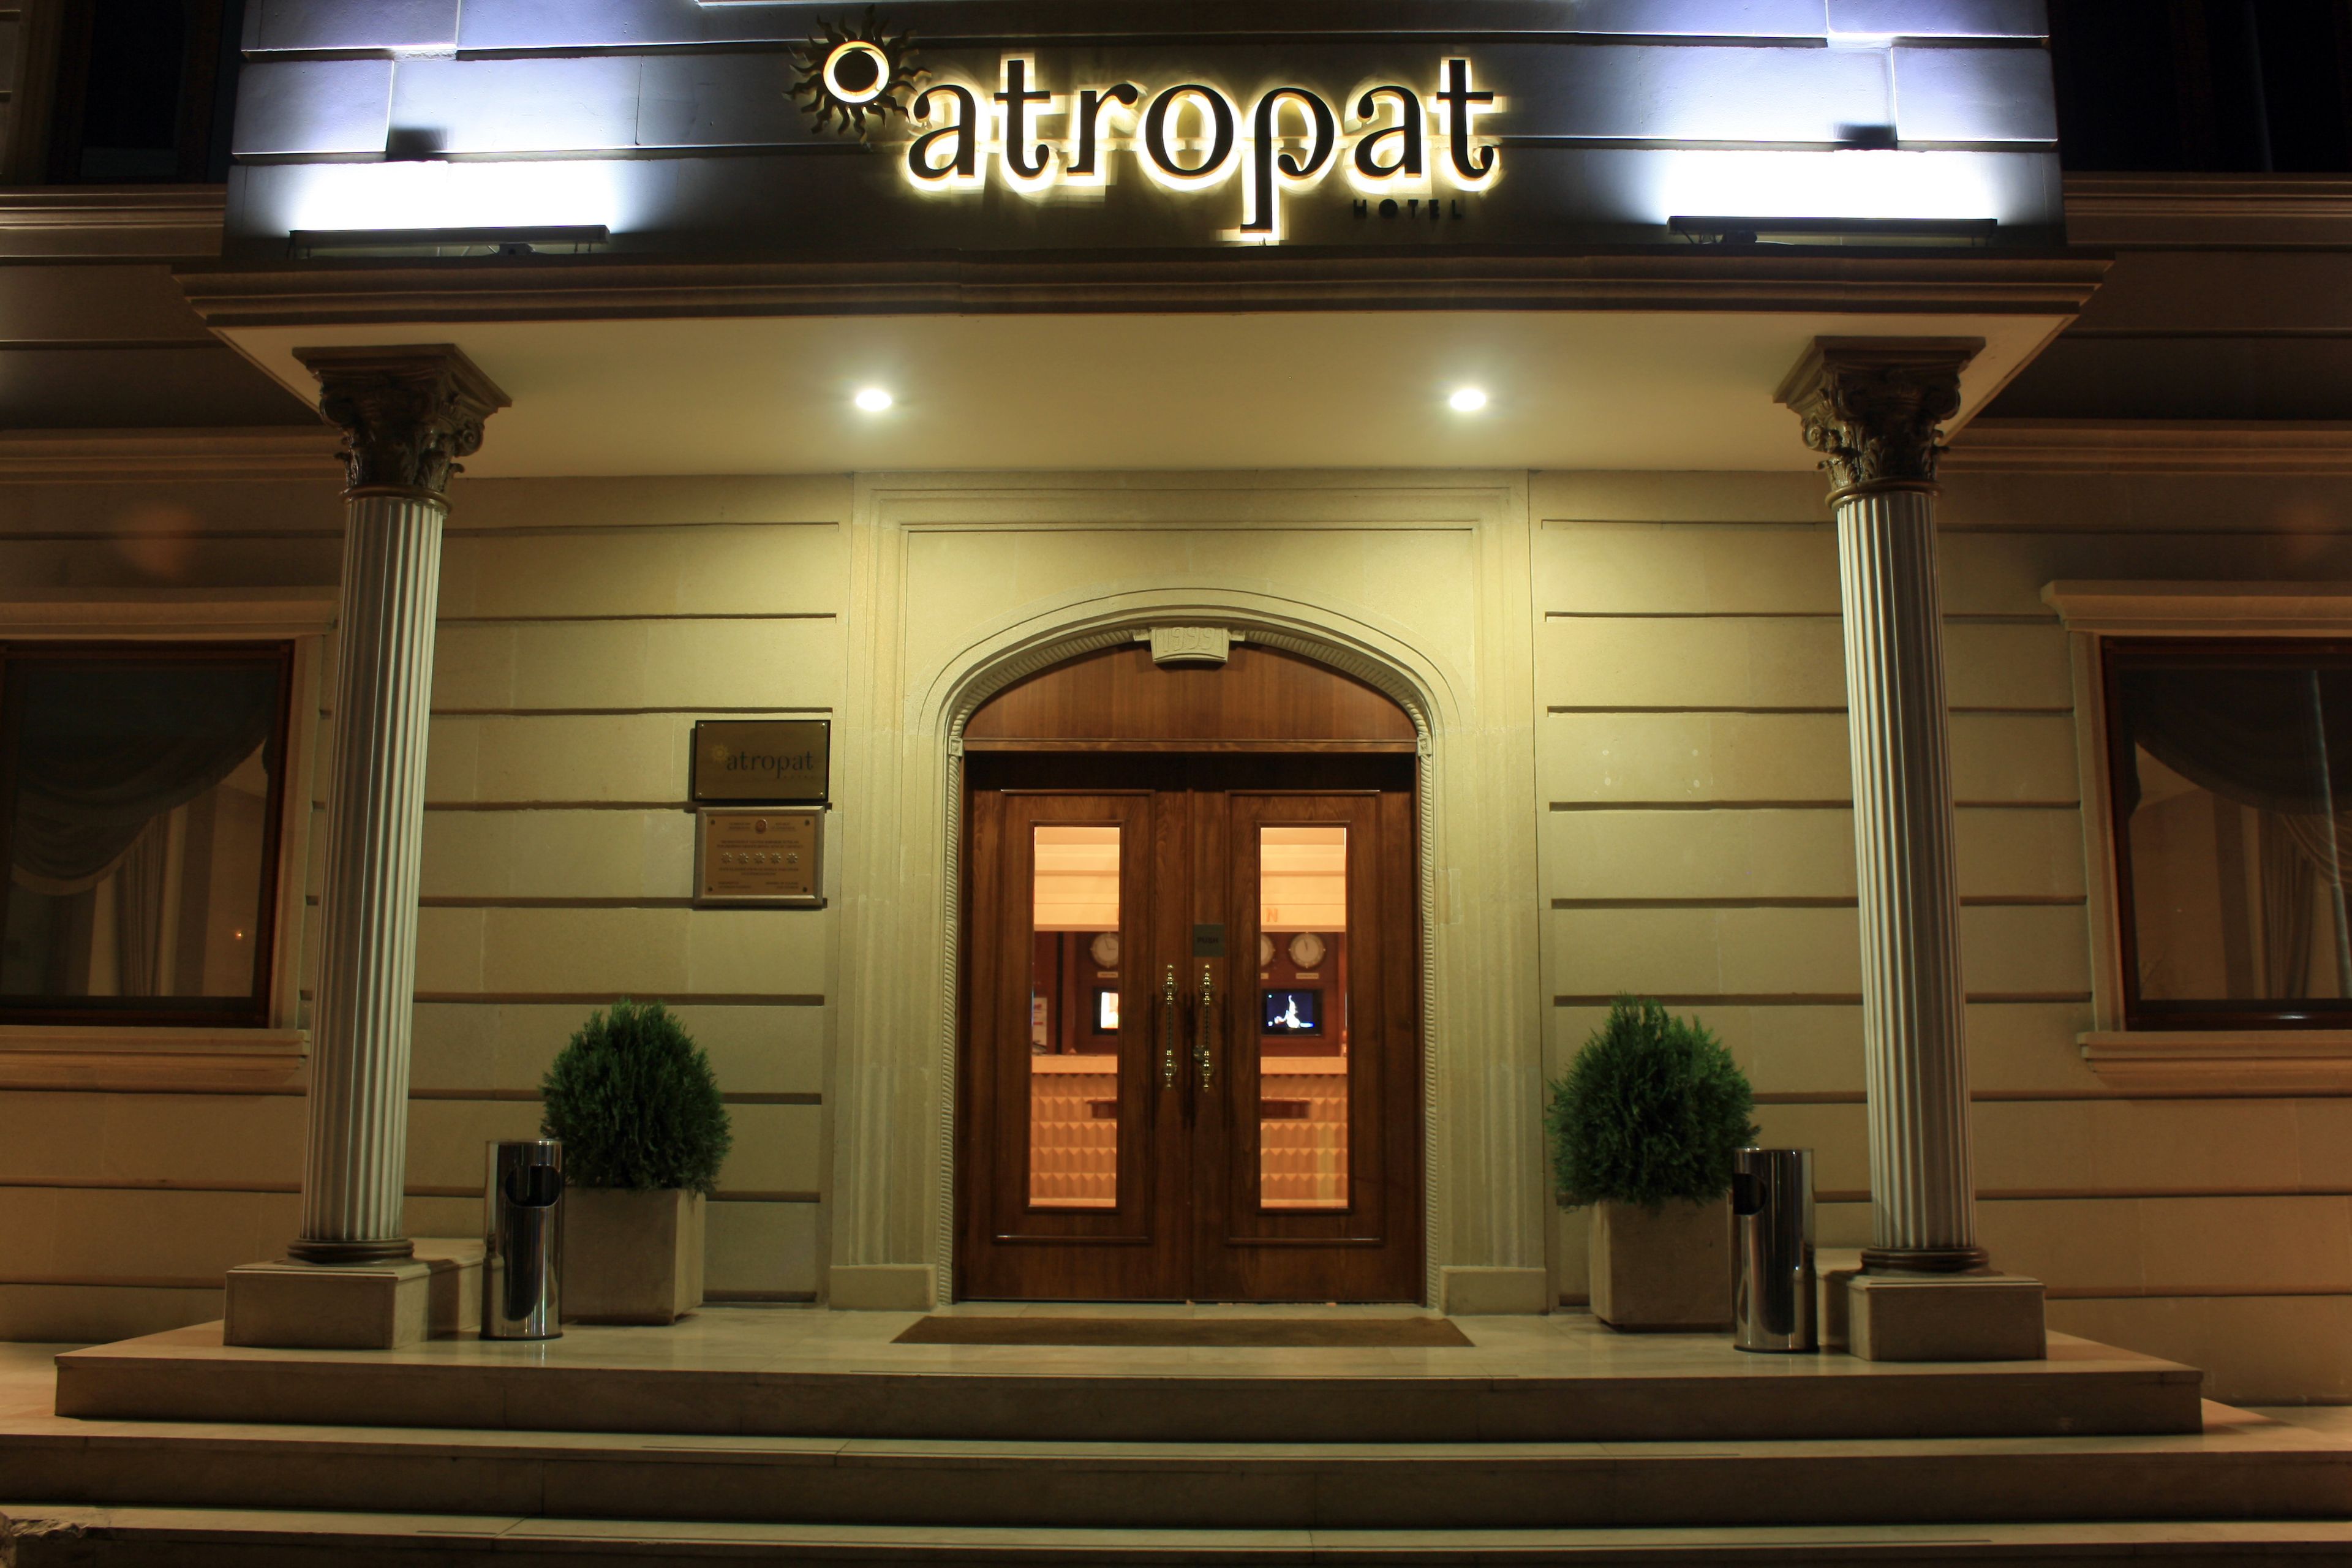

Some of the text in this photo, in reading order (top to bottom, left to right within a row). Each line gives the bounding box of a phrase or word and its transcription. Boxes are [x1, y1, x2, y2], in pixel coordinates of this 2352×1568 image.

[908, 59, 1494, 233] atropat
[1353, 198, 1463, 219] HOTEL
[1161, 627, 1215, 652] 1999
[726, 750, 813, 779] atropat
